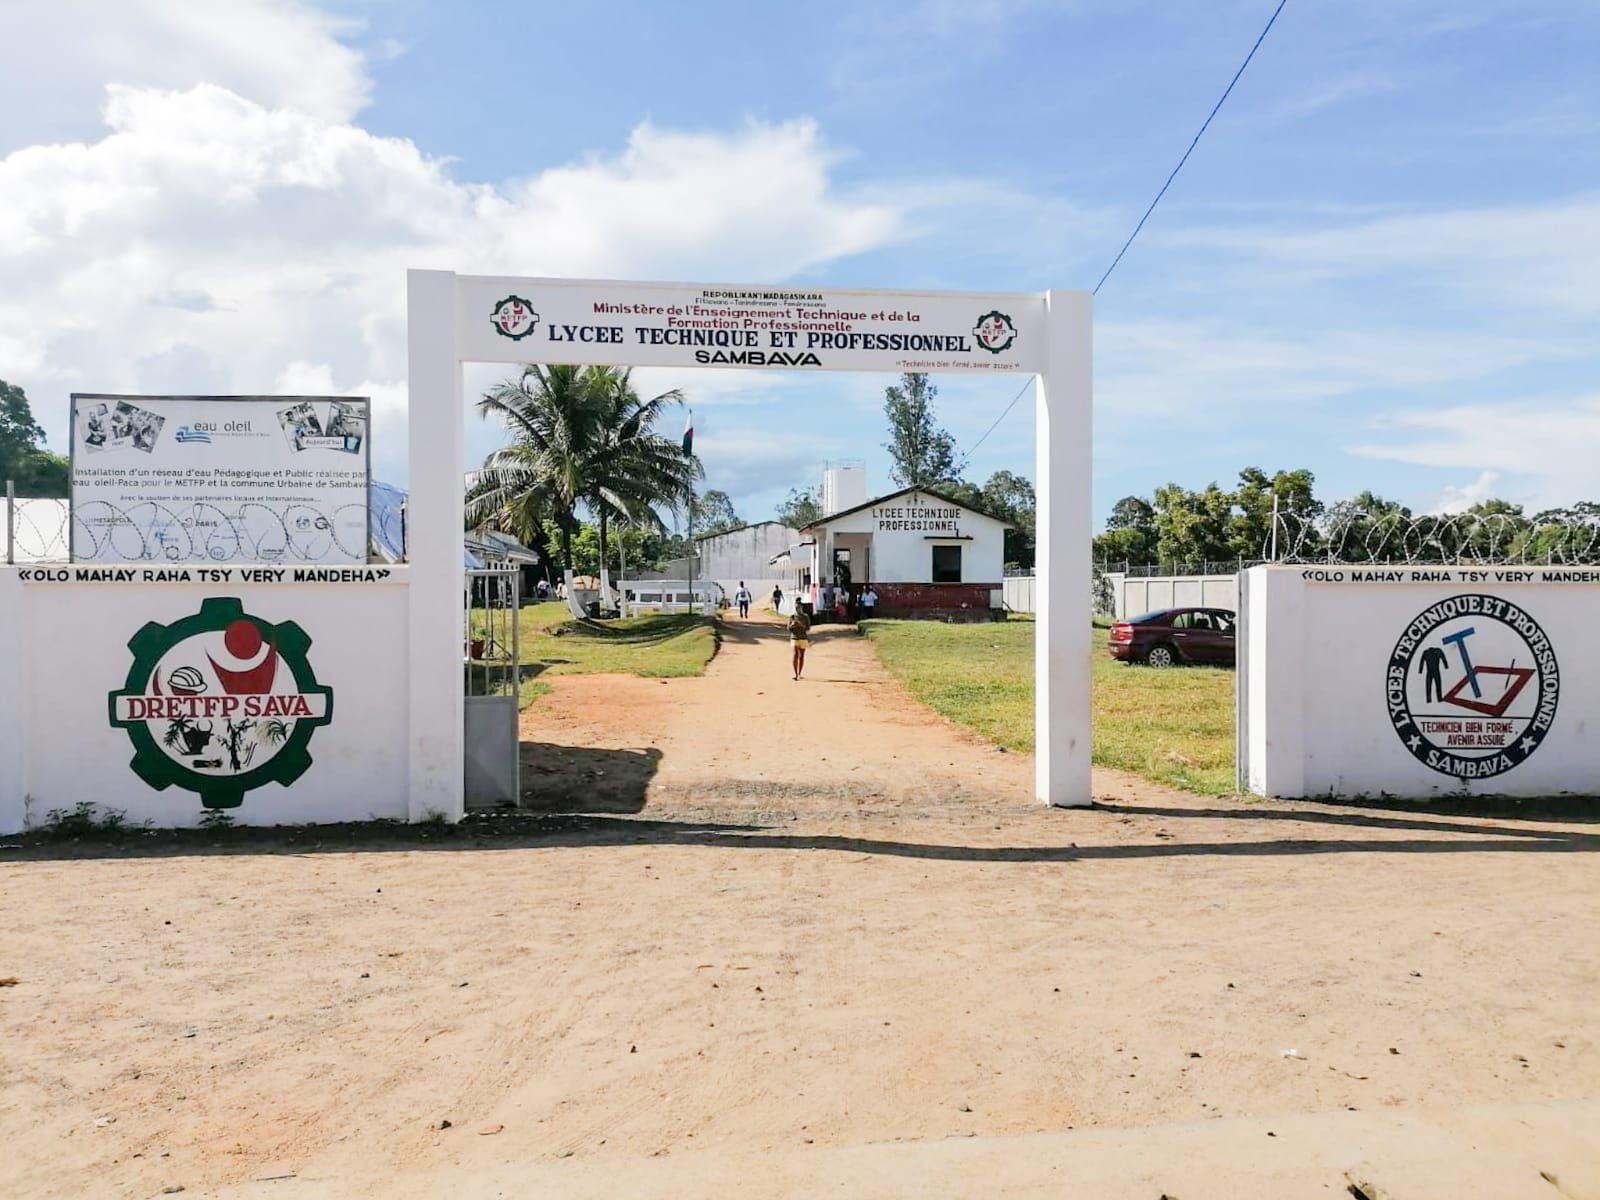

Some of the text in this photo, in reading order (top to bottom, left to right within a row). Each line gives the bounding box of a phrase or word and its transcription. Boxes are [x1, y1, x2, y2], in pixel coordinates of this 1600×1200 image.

[764, 291, 823, 301] MADAGASIKARA
[594, 302, 920, 322] Ministère de l'Enseignement Technique et de la
[668, 317, 852, 332] Formation Professionnelle
[548, 324, 972, 353] LYCEE TECHNIQUE ET PROFESSIONNEL
[695, 350, 822, 367] SAMBAVA
[193, 420, 252, 432] eau oleil
[75, 468, 126, 476] Installation
[128, 468, 149, 476] d'un
[186, 468, 211, 477] d'eau
[285, 469, 313, 478] Public
[141, 480, 161, 488] pour
[164, 479, 173, 487] le
[175, 479, 205, 487] METFP
[207, 479, 216, 487] et
[220, 479, 228, 487] la
[231, 480, 274, 488] commune
[277, 480, 313, 488] Urbaine
[315, 480, 326, 488] de
[872, 508, 961, 519] LYCEE TECHNIQUE
[879, 520, 958, 531] PROFESSIONNEL
[75, 569, 137, 582] MAHAY
[143, 570, 191, 582] RAHA
[197, 569, 233, 582] TSY
[240, 569, 286, 582] VERY
[1351, 571, 1404, 582] MAHAY
[1411, 571, 1451, 582] RAHA
[1458, 571, 1489, 582] TSY
[1495, 571, 1534, 582] VERY
[1542, 571, 1600, 582] MANDEH
[1387, 596, 1559, 731] LYCEE TECHNIQUE ET PROFESSIONNEL
[126, 695, 314, 719] DRETFP SAVA
[1465, 721, 1483, 733] BIEN
[1447, 734, 1475, 746] AVENIR
[1426, 749, 1515, 777] SAMBAVA
